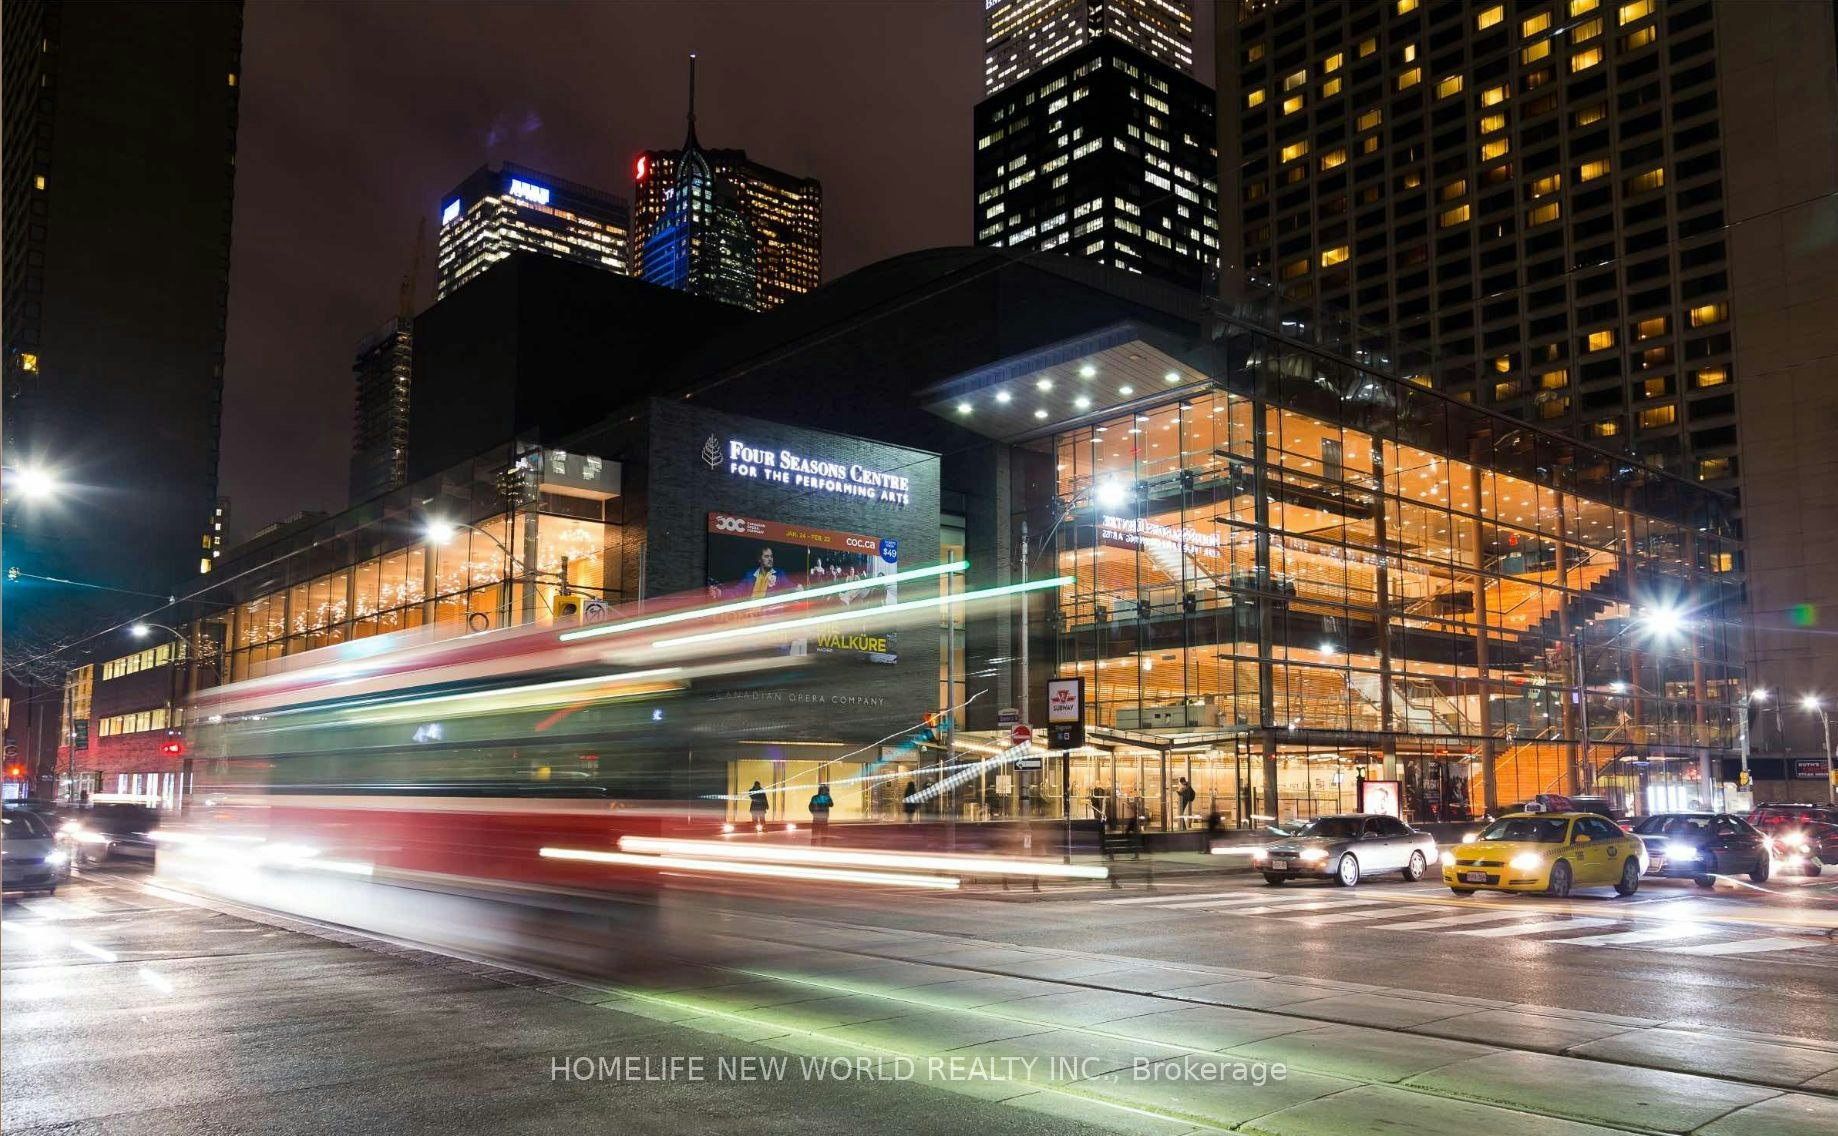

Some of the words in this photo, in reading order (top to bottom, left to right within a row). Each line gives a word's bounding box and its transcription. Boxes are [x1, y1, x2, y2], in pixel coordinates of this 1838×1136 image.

[729, 440, 775, 466] FOUR
[780, 450, 846, 479] SEASONS
[850, 464, 909, 491] CENTRE
[730, 463, 757, 477] FOR
[764, 468, 790, 483] THE
[795, 474, 875, 498] PERFORMING
[880, 489, 909, 504] ARTS
[846, 537, 876, 550] coc.ca
[883, 547, 897, 558] $49
[816, 633, 887, 653] WALKÜRE
[788, 692, 826, 704] OPERA
[831, 695, 885, 706] COMPANY
